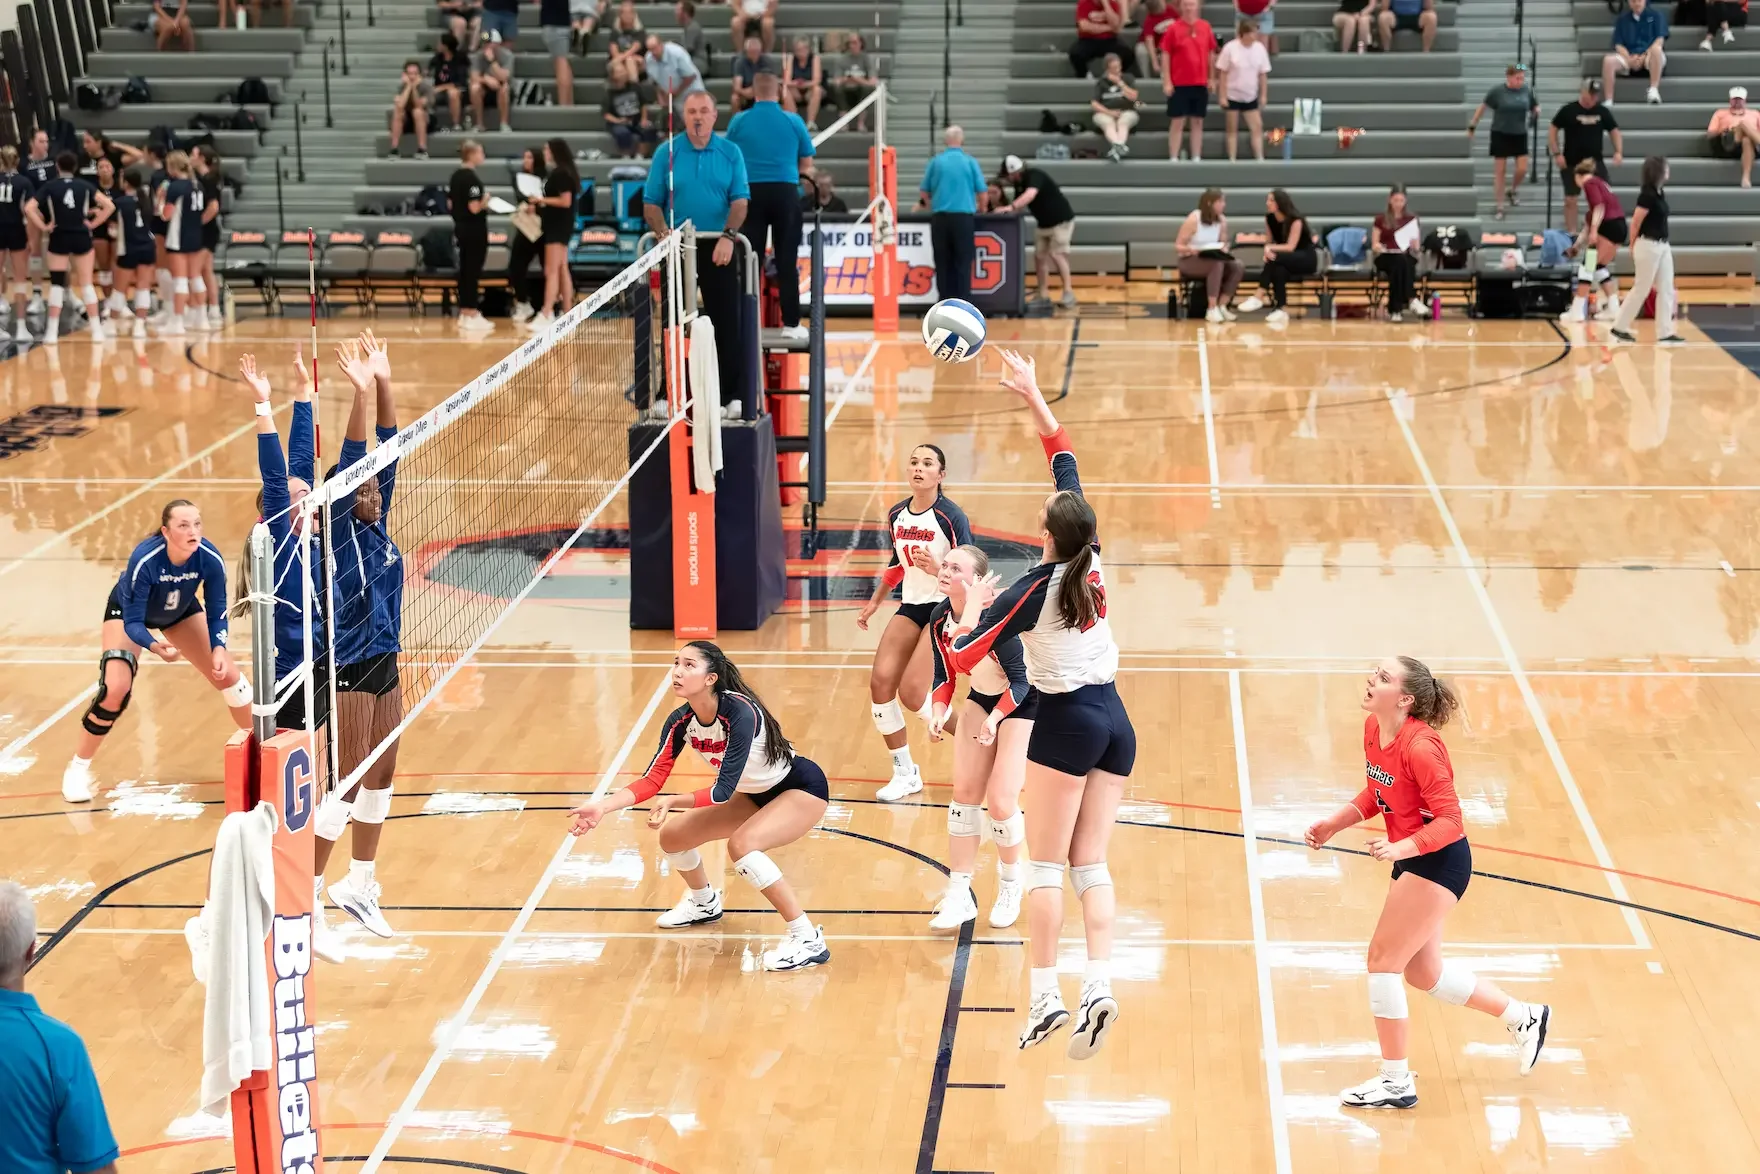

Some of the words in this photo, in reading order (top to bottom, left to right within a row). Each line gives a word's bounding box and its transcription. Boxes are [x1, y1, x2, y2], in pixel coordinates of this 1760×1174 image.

[63, 188, 76, 209] 4
[898, 232, 923, 246] HE
[969, 231, 1006, 295] G
[896, 525, 936, 542] Bullets
[164, 588, 181, 611] 9
[690, 736, 728, 754] Bulle
[283, 745, 314, 835] G
